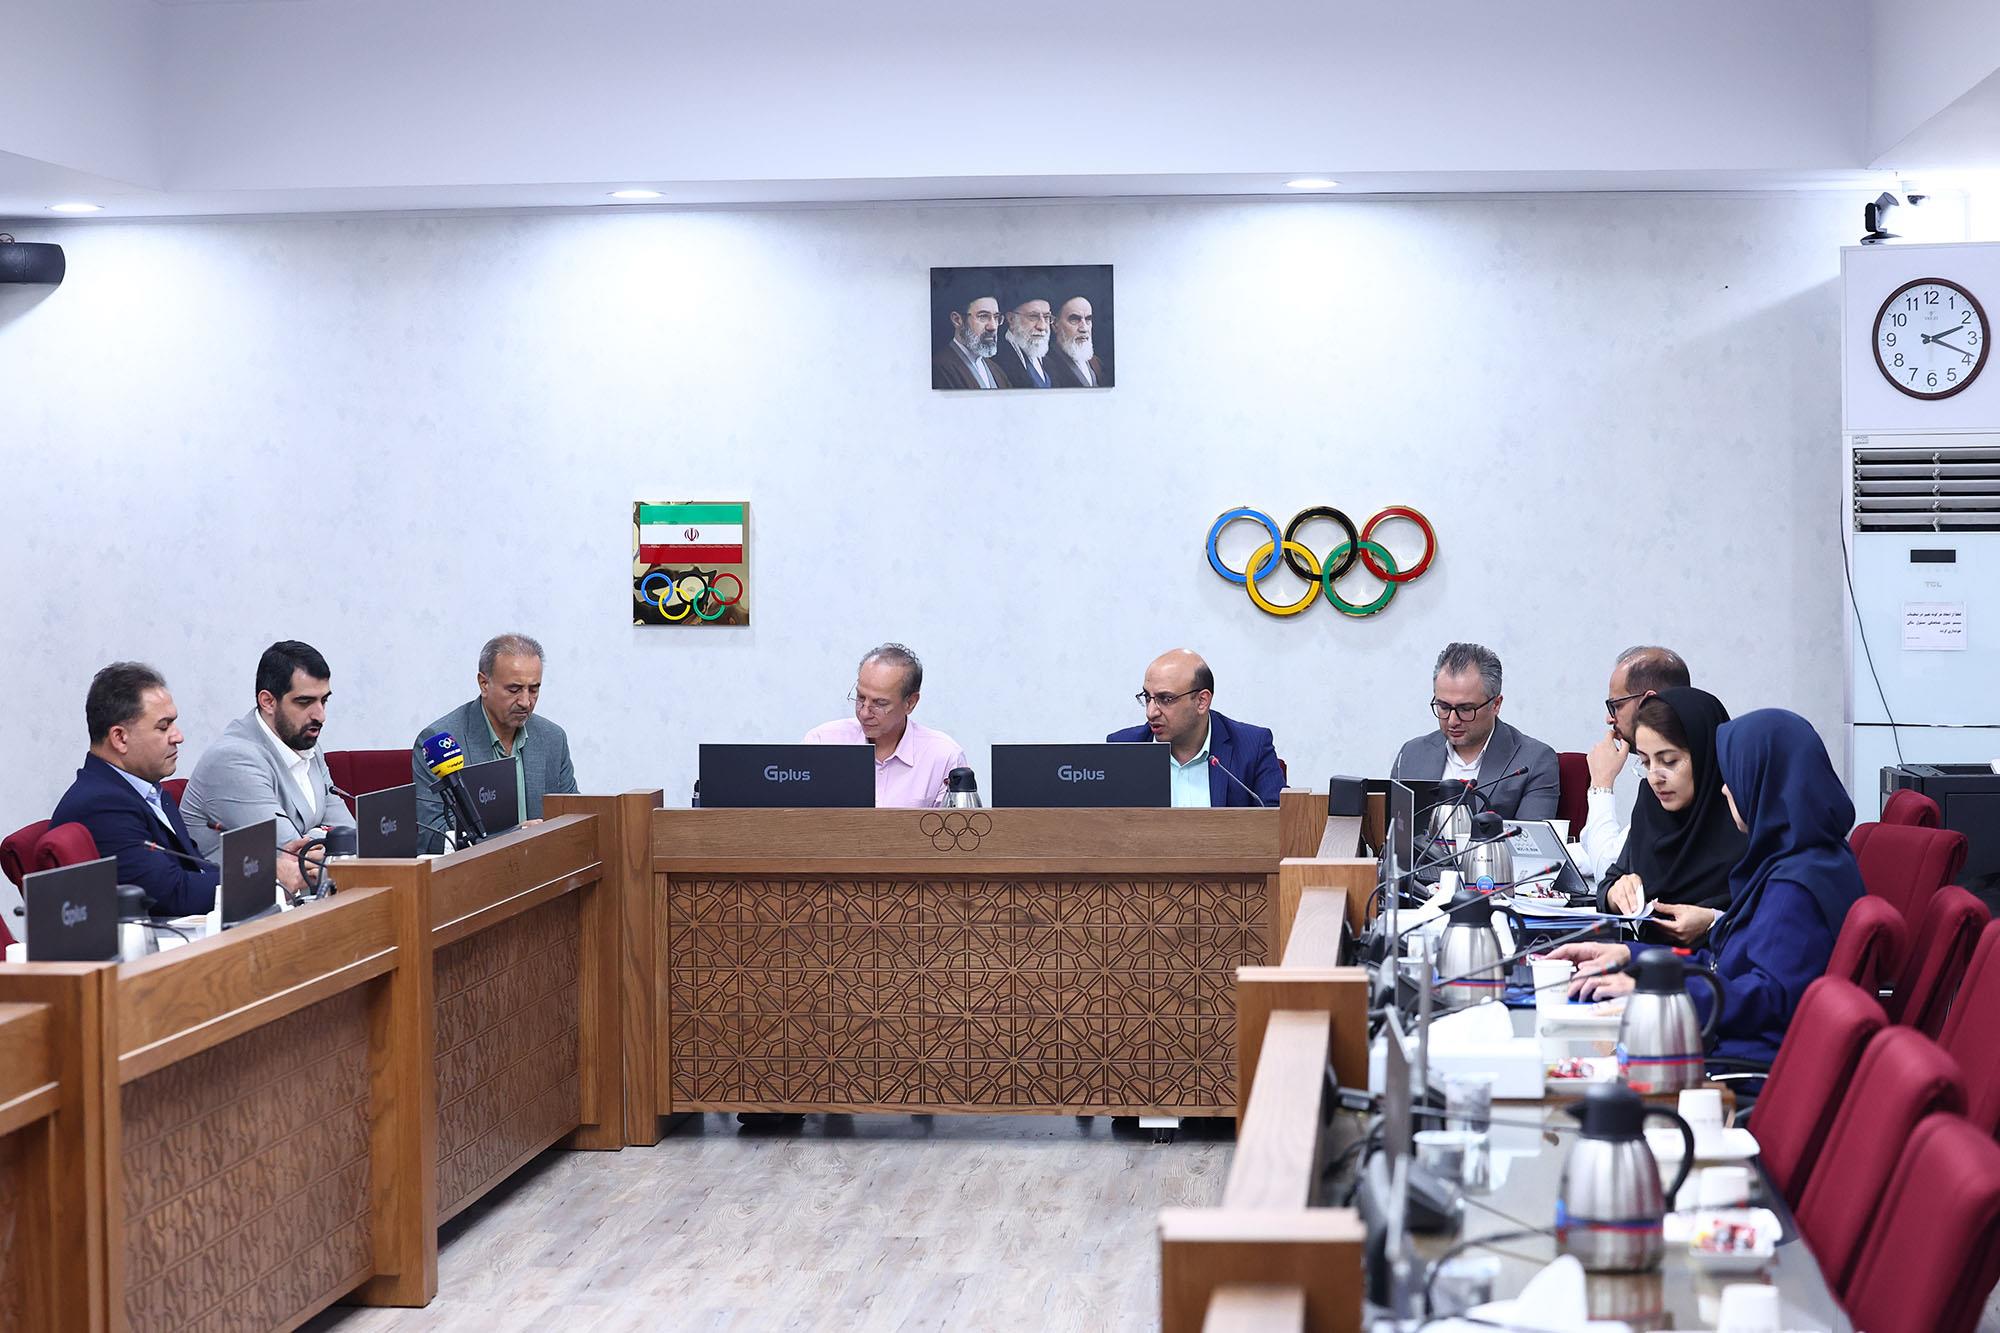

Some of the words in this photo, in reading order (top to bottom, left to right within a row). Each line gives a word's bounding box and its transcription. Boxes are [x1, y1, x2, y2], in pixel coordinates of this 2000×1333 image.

[1906, 298, 1918, 311] 11
[1924, 291, 1939, 304] 12
[1949, 296, 1954, 309] 1
[1892, 313, 1907, 327] 10
[1962, 311, 1971, 324] 2
[1886, 332, 1897, 347] 9
[1968, 331, 1978, 345] 3
[1894, 352, 1904, 367] 8
[1962, 352, 1971, 366] 4
[1909, 368, 1918, 381] 7
[1927, 372, 1937, 387] 6
[1947, 368, 1957, 381] 5
[763, 765, 811, 783] Gplus
[1057, 765, 1105, 783] Gplus
[479, 786, 496, 805] Gplus
